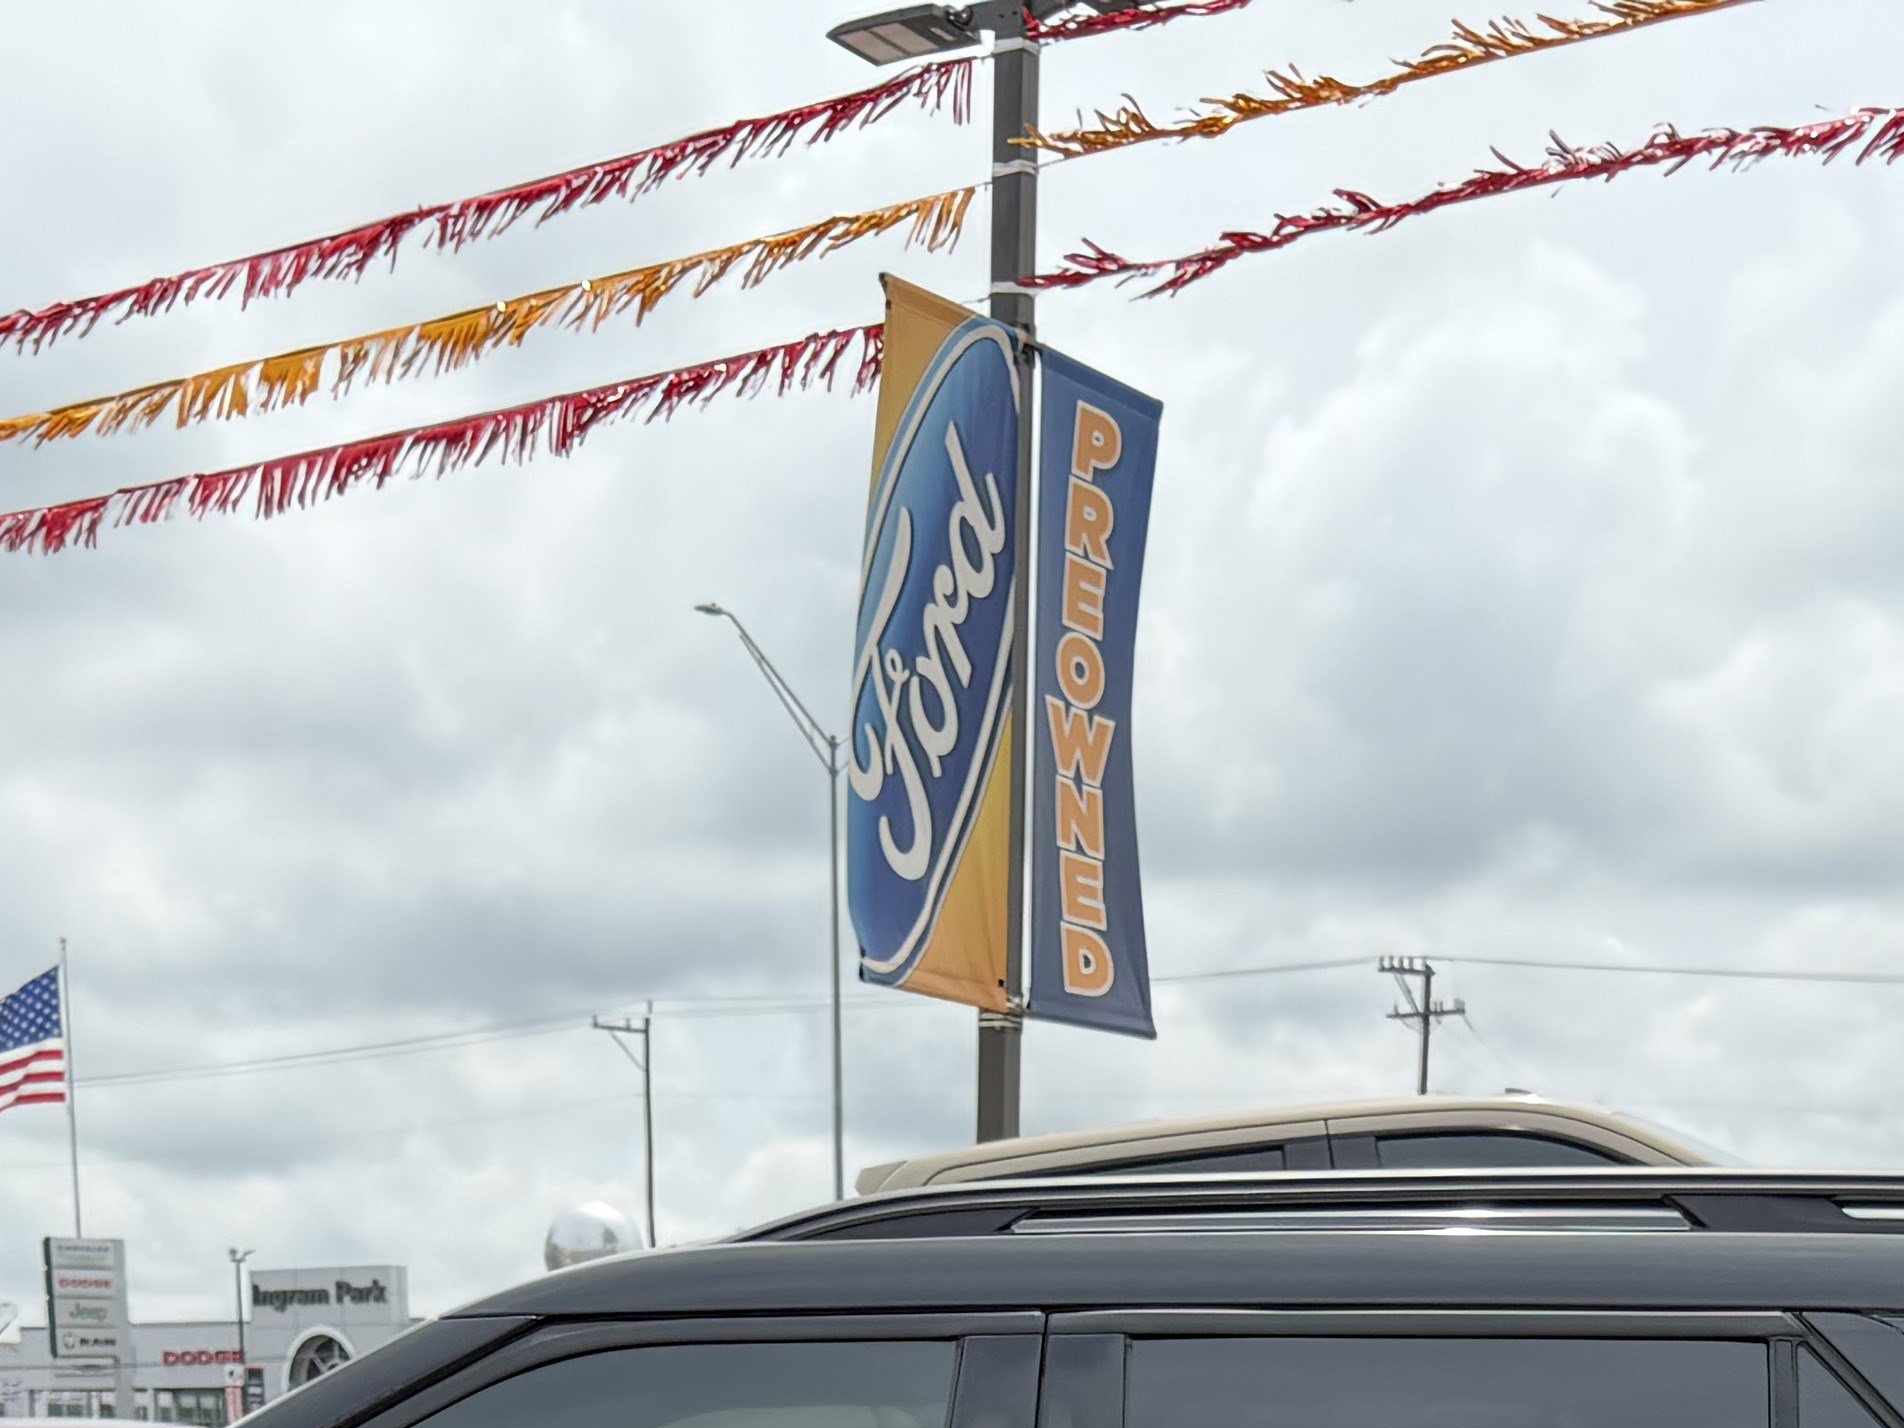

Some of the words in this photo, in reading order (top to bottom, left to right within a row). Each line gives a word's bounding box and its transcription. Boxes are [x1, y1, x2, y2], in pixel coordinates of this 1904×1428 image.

[849, 419, 1006, 882] Ford
[1043, 399, 1123, 998] PREOWNED
[252, 1283, 331, 1314] Ingram
[334, 1278, 387, 1305] Park
